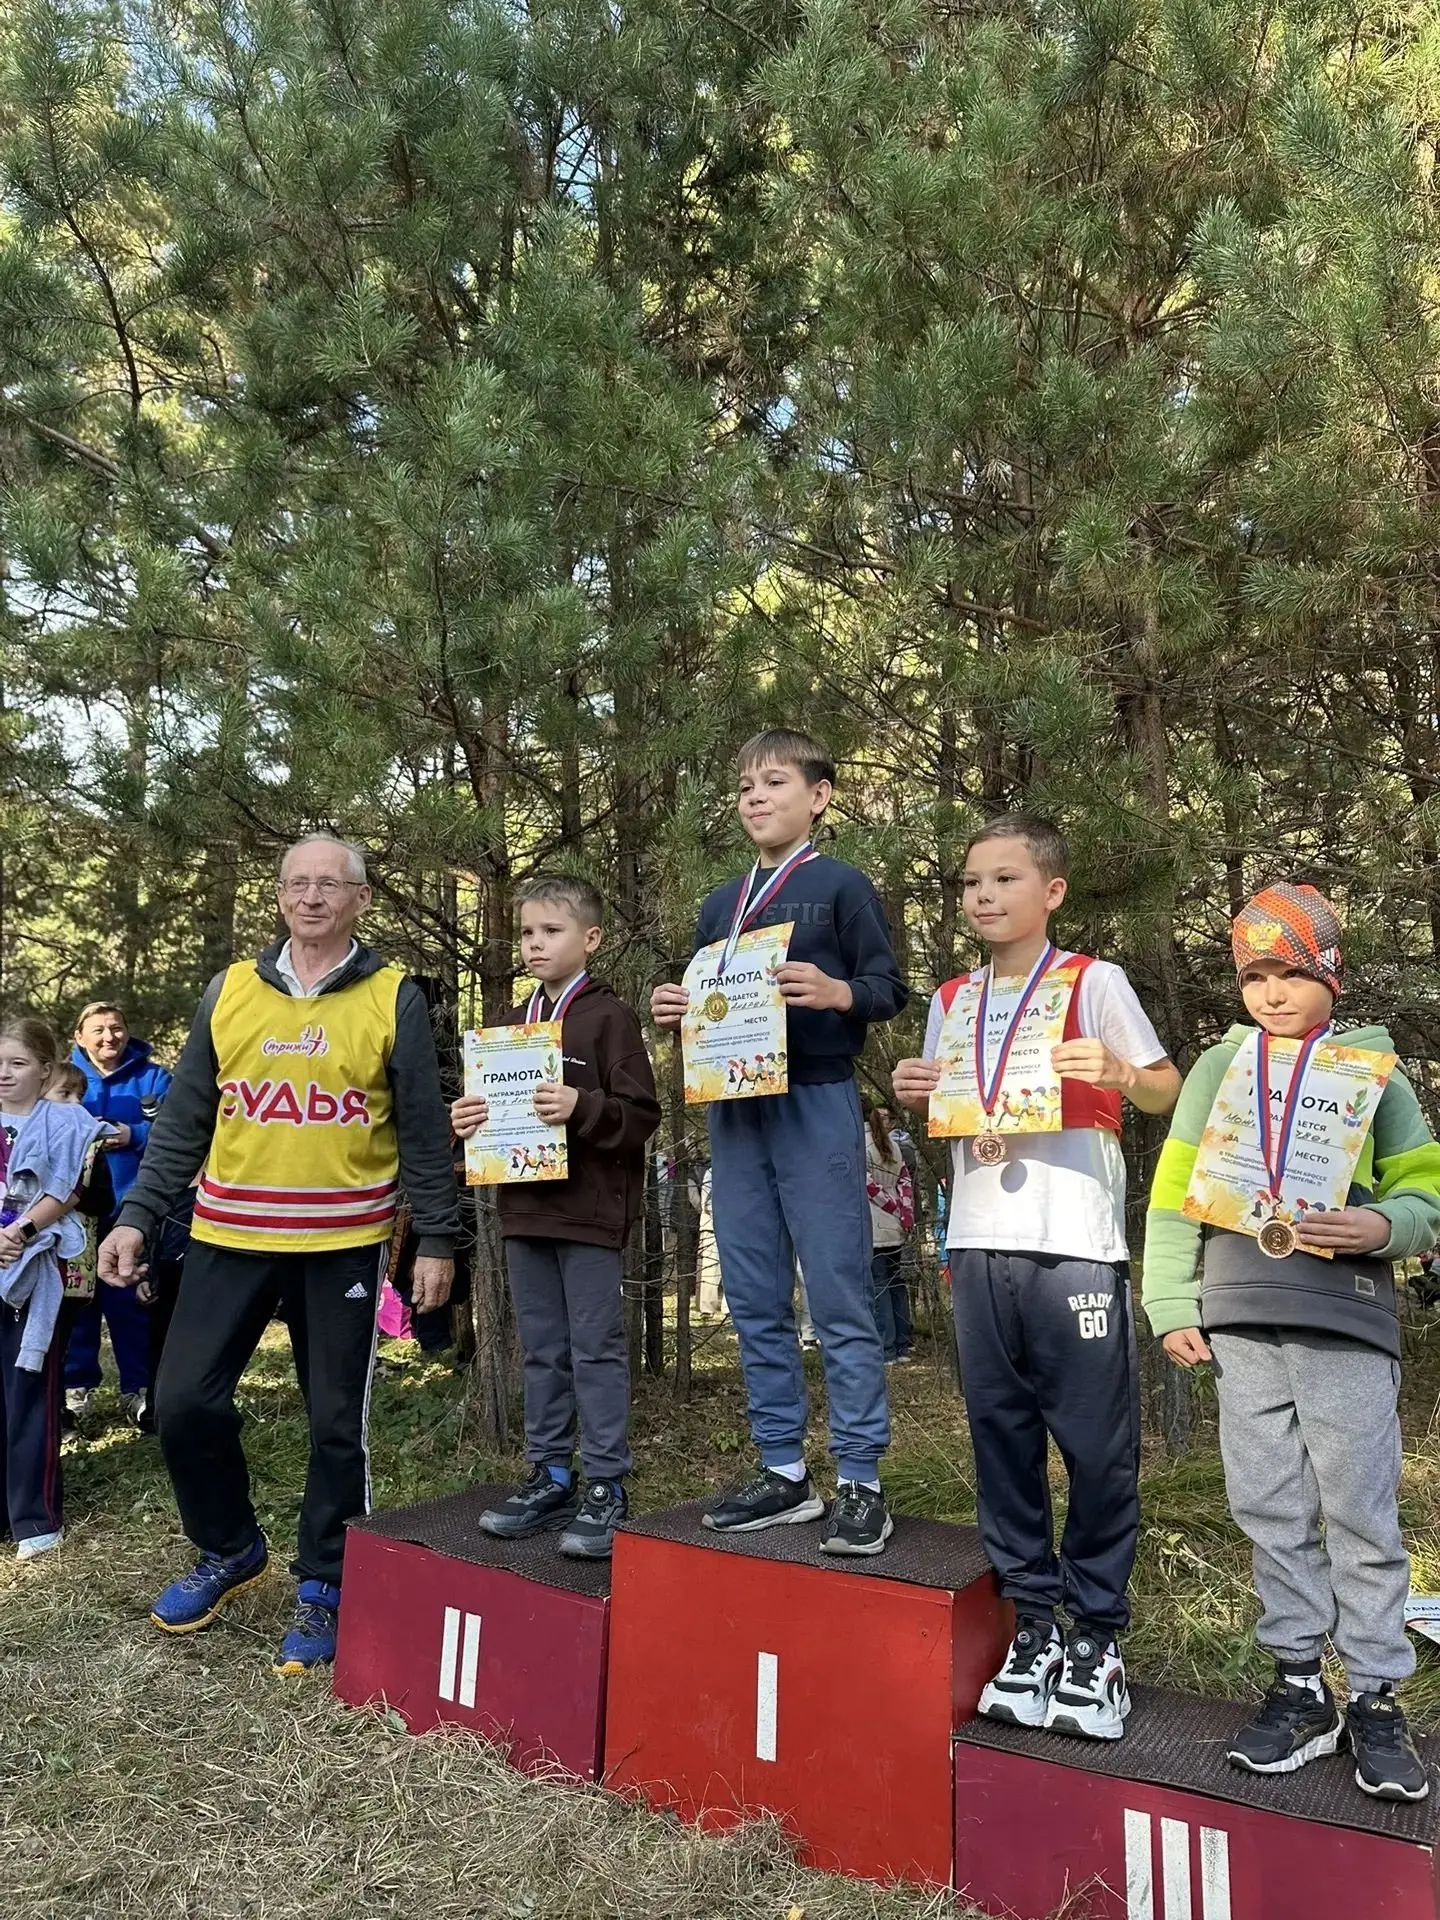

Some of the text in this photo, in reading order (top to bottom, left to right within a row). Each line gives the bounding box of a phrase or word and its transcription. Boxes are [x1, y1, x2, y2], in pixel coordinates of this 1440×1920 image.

[701, 970, 763, 989] ГРАМОТА
[727, 991, 759, 1001] ДАЕТСЯ
[744, 1015, 769, 1024] МЕСТО
[1011, 1048, 1040, 1056] МЕСТО
[483, 1069, 544, 1084] ГРАМОТА
[488, 1088, 537, 1098] НАГРАЖДАЕТС
[220, 1080, 370, 1125] СУДЬЯ
[1295, 1150, 1330, 1165] МЕСТО
[1067, 1293, 1113, 1311] READY
[1079, 1309, 1108, 1339] GO
